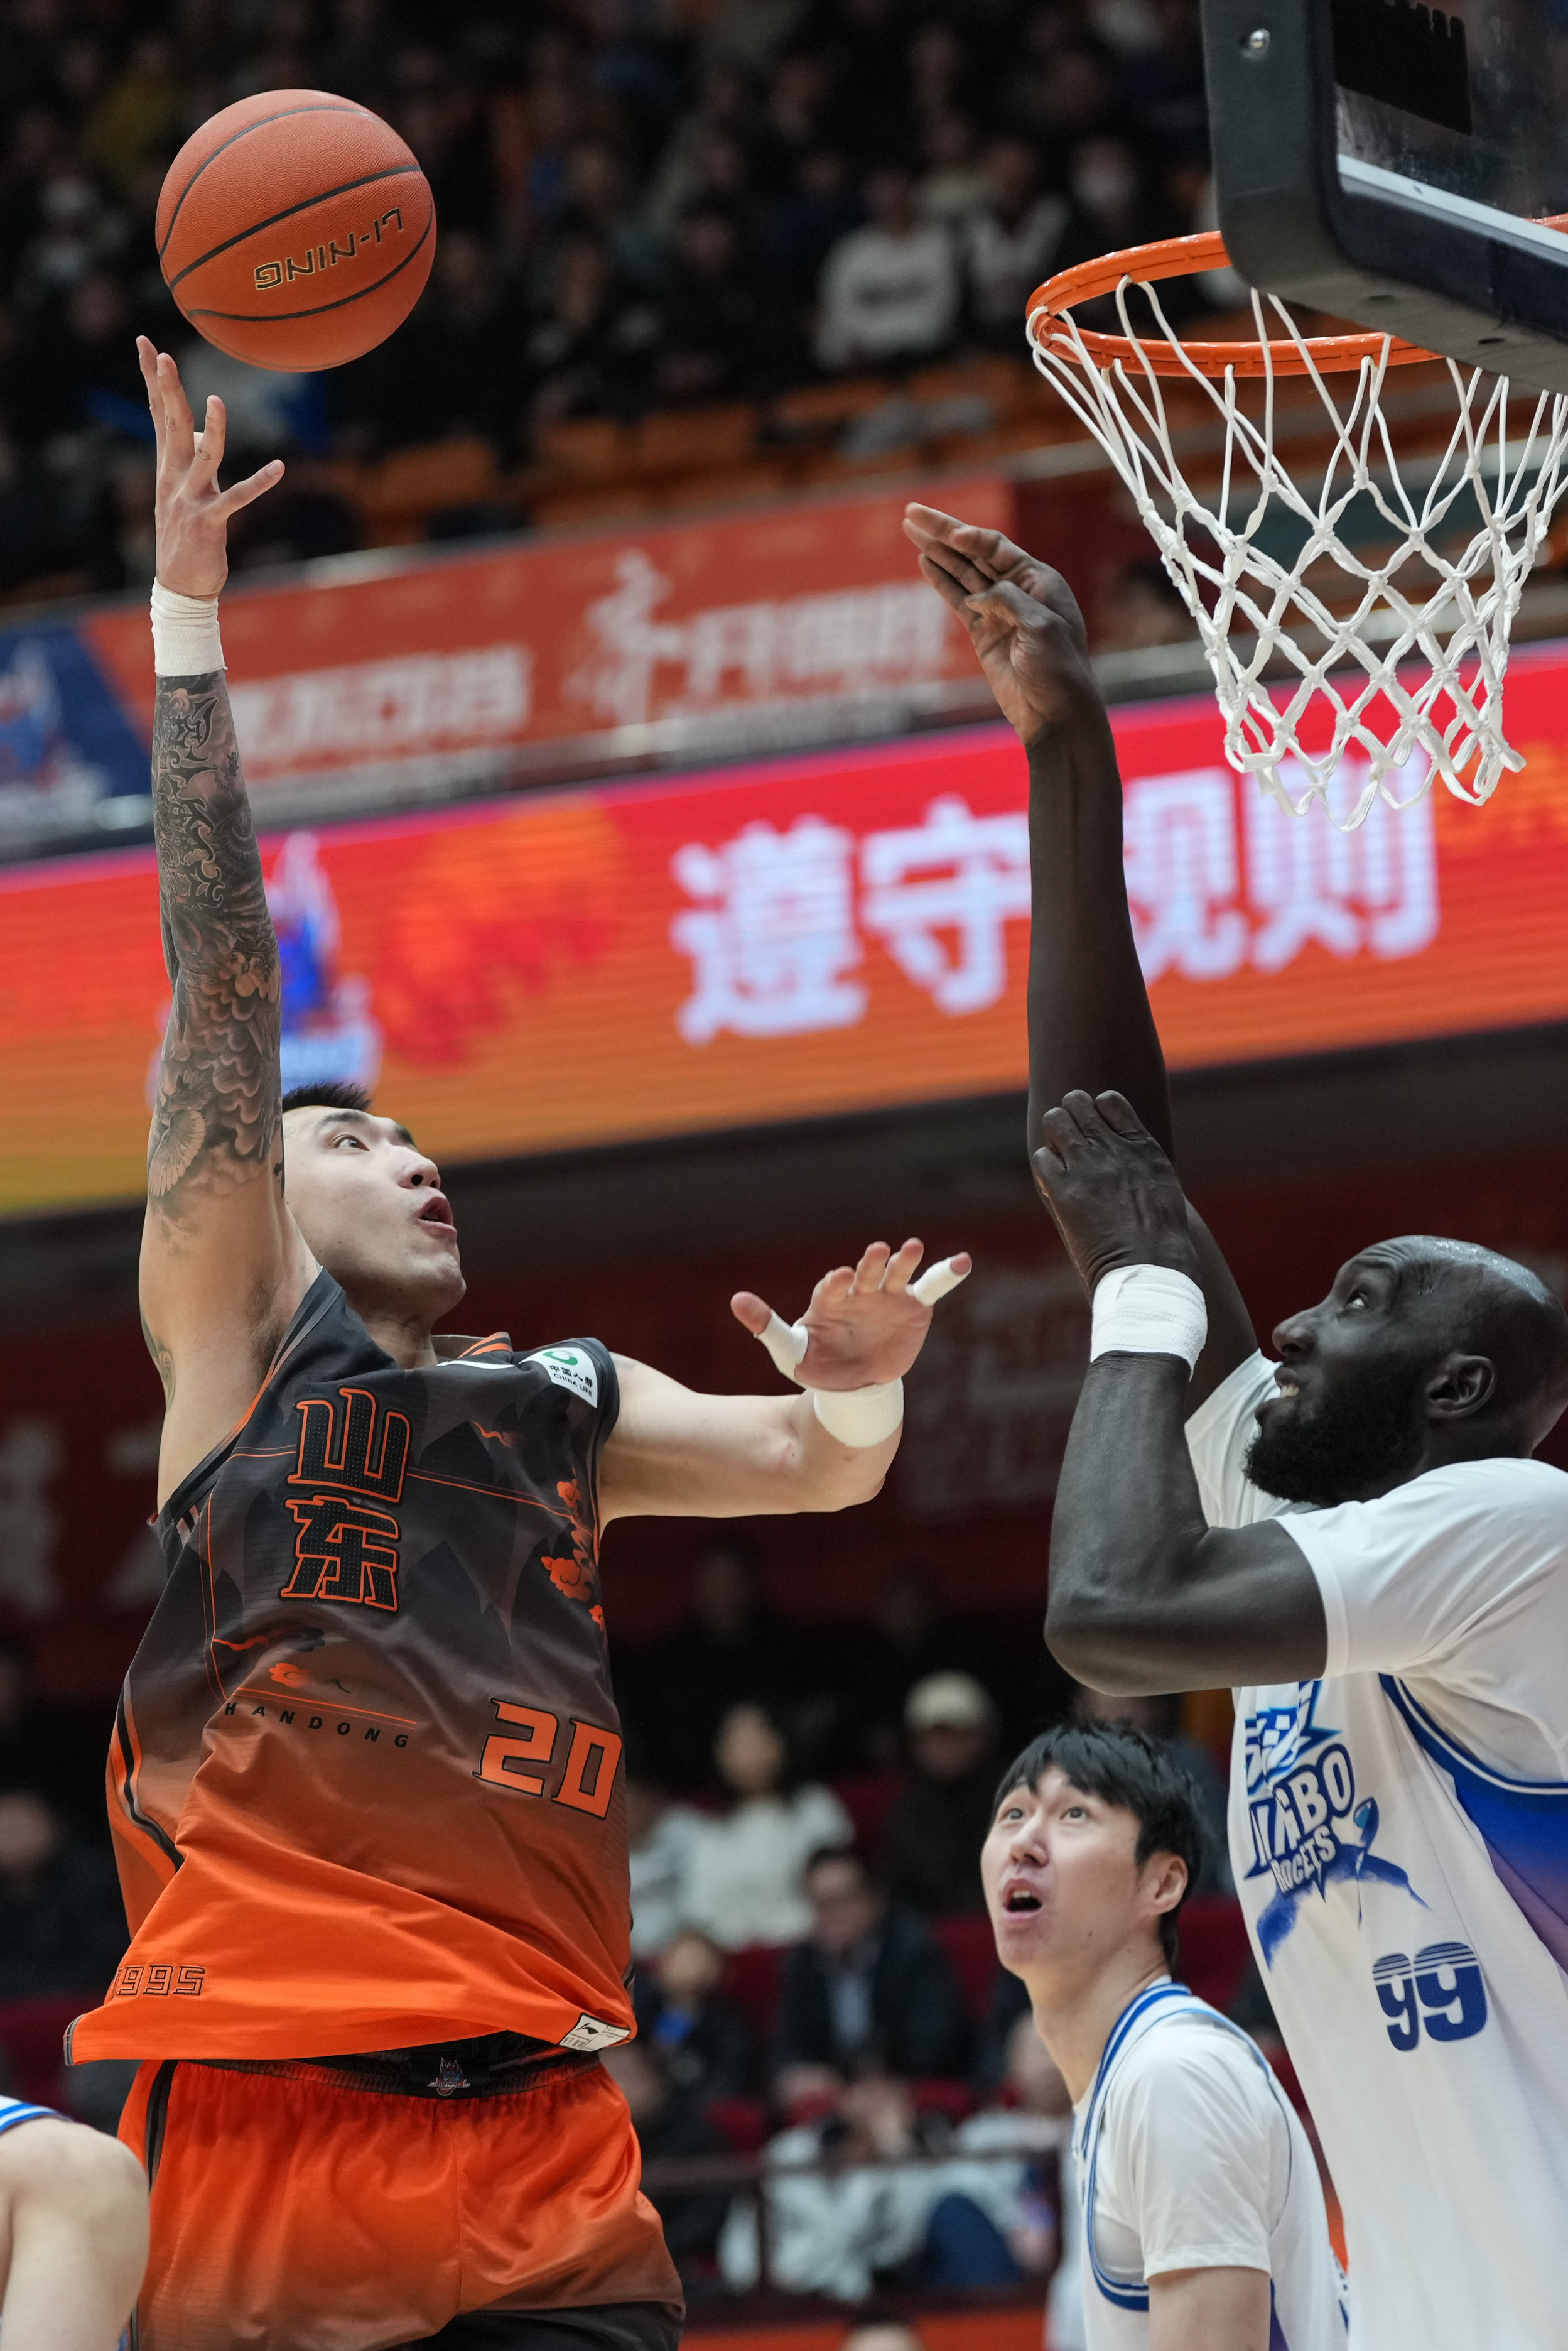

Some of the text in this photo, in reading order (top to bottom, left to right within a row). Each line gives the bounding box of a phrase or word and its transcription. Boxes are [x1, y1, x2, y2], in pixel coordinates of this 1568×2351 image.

[254, 207, 404, 290] LI-NING
[671, 740, 1440, 1045] 遵守规则
[549, 1364, 593, 1388] 中国人寿
[554, 1373, 593, 1398] CHINA LIFE
[278, 1385, 414, 1614] 山东
[472, 1697, 624, 1820] 20
[1372, 1941, 1488, 2052] 99
